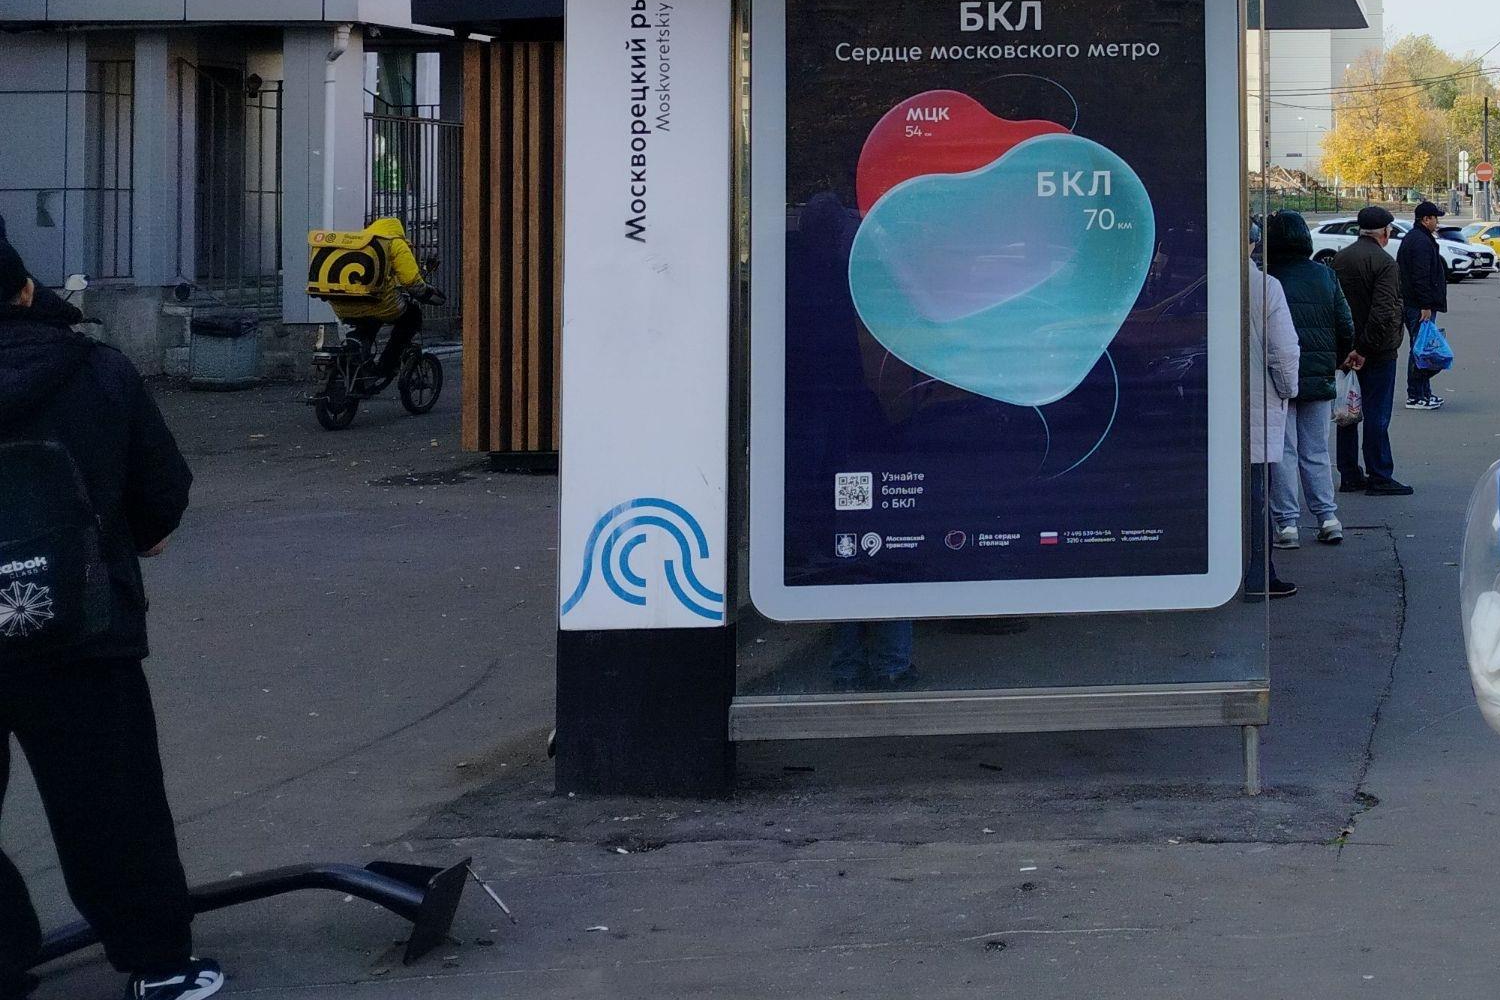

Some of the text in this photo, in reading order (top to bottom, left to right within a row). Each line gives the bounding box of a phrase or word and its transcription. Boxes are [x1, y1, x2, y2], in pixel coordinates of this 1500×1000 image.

[960, 1, 1042, 32] БКЛ
[835, 41, 1160, 65] Сердце московского метро
[655, 2, 673, 132] Moskvoretskiy
[906, 107, 950, 123] МЦК
[905, 125, 923, 138] 54
[625, 38, 652, 243] Москворецкий
[1037, 170, 1111, 197] БКЛ
[1083, 208, 1133, 231] 70 км
[881, 472, 925, 482] Узнайте
[881, 485, 924, 495] больше
[881, 498, 916, 509] о БКЛ
[885, 534, 925, 542] Московский
[979, 533, 993, 541] Два
[886, 542, 919, 550] транспорт
